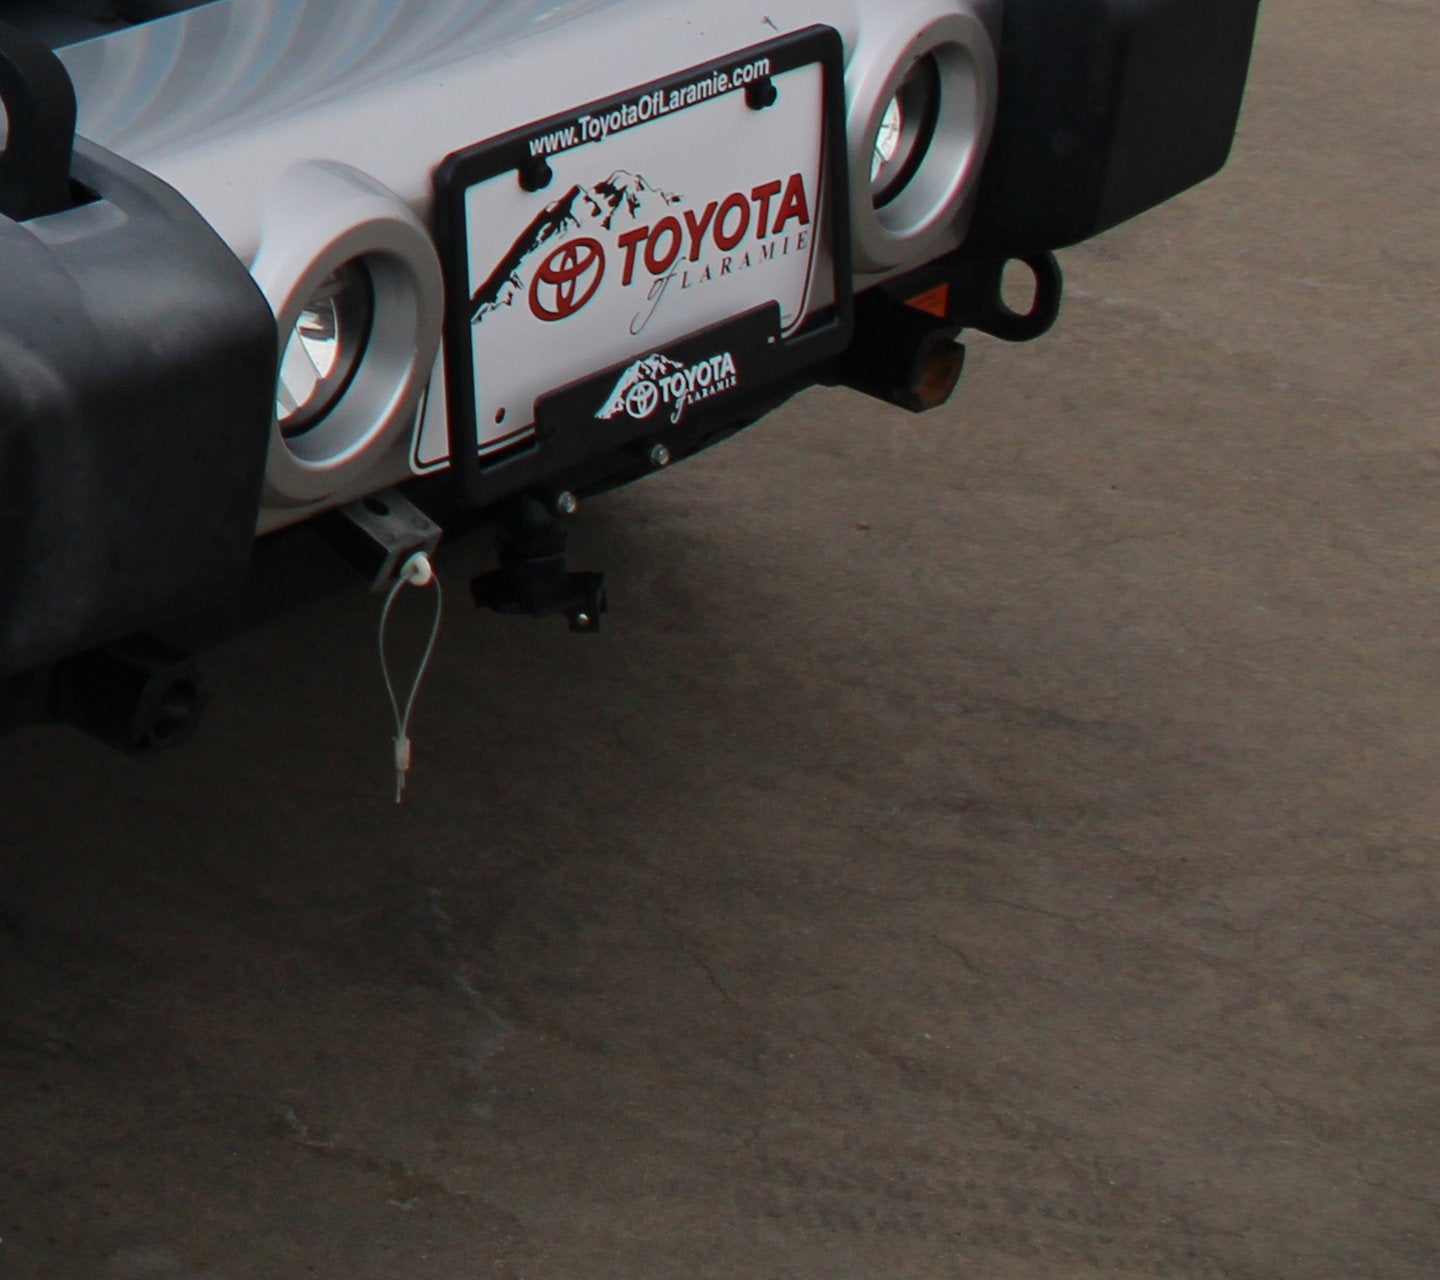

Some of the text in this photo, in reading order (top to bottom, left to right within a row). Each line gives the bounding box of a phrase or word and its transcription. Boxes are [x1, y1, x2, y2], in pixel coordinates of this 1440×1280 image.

[529, 57, 770, 156] www.ToyotaOfLaramie.com
[617, 172, 810, 287] TOYOTA
[629, 231, 810, 336] of LARAMIE
[658, 351, 737, 403] TOYOTA
[687, 375, 737, 405] LARAMIE
